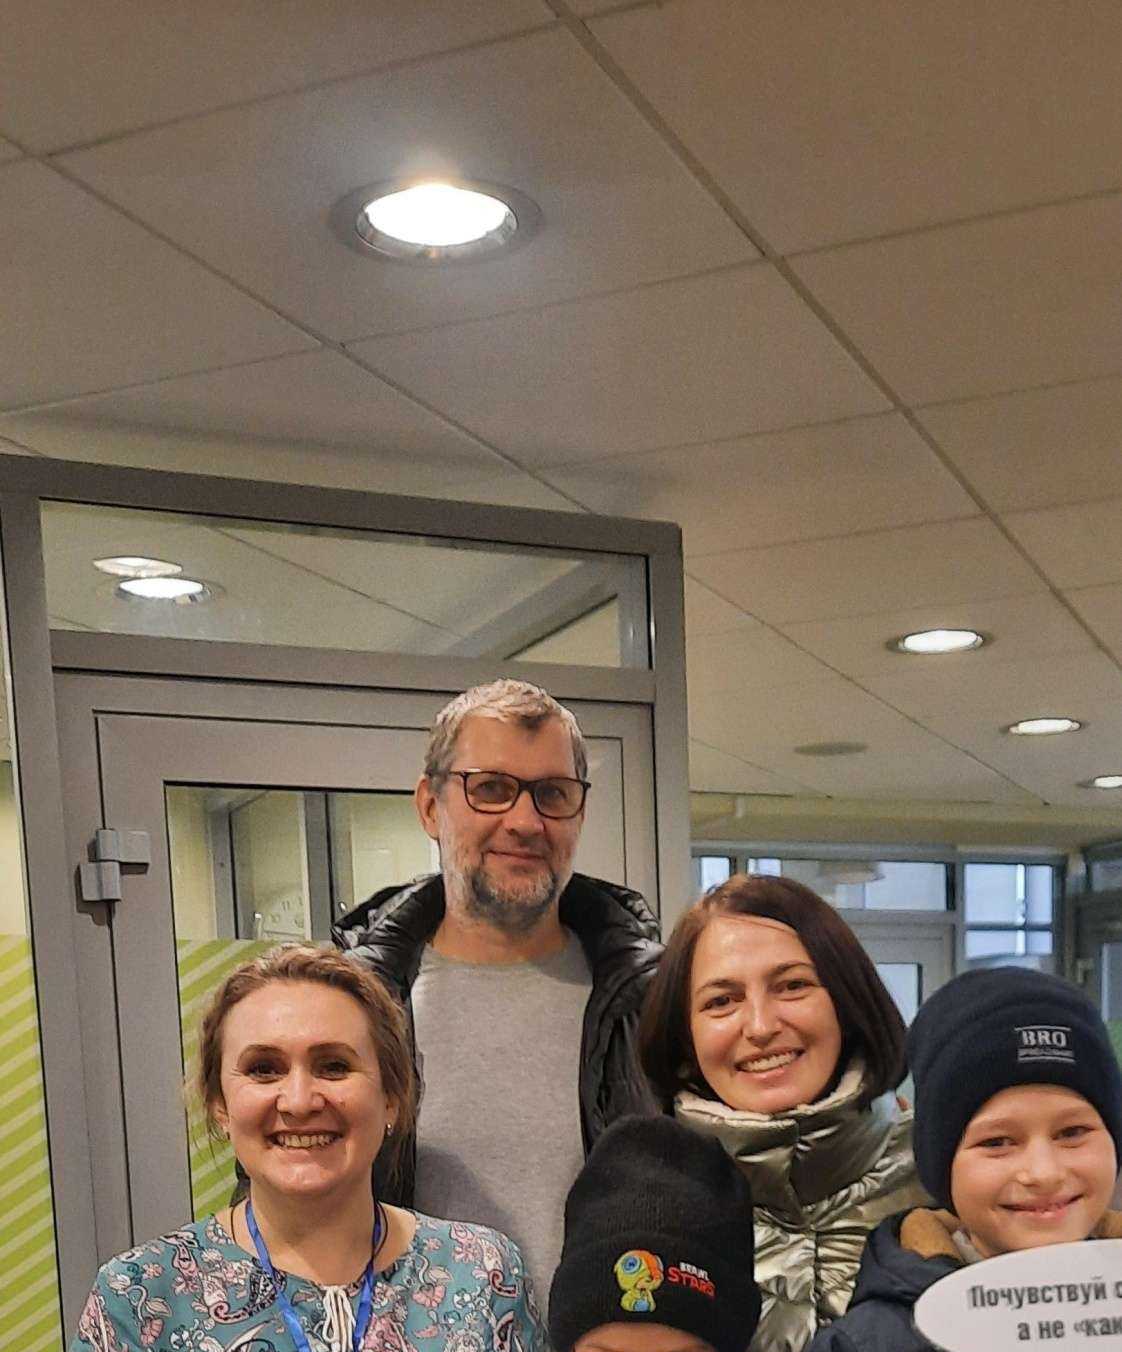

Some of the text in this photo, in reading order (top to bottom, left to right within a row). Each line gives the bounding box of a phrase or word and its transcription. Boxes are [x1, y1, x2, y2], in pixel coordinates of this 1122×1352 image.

[1022, 1030, 1067, 1048] BRO
[667, 1266, 716, 1297] STARS
[970, 1276, 1106, 1309] Почувствуй
[1018, 1322, 1030, 1340] а
[1039, 1320, 1064, 1339] не
